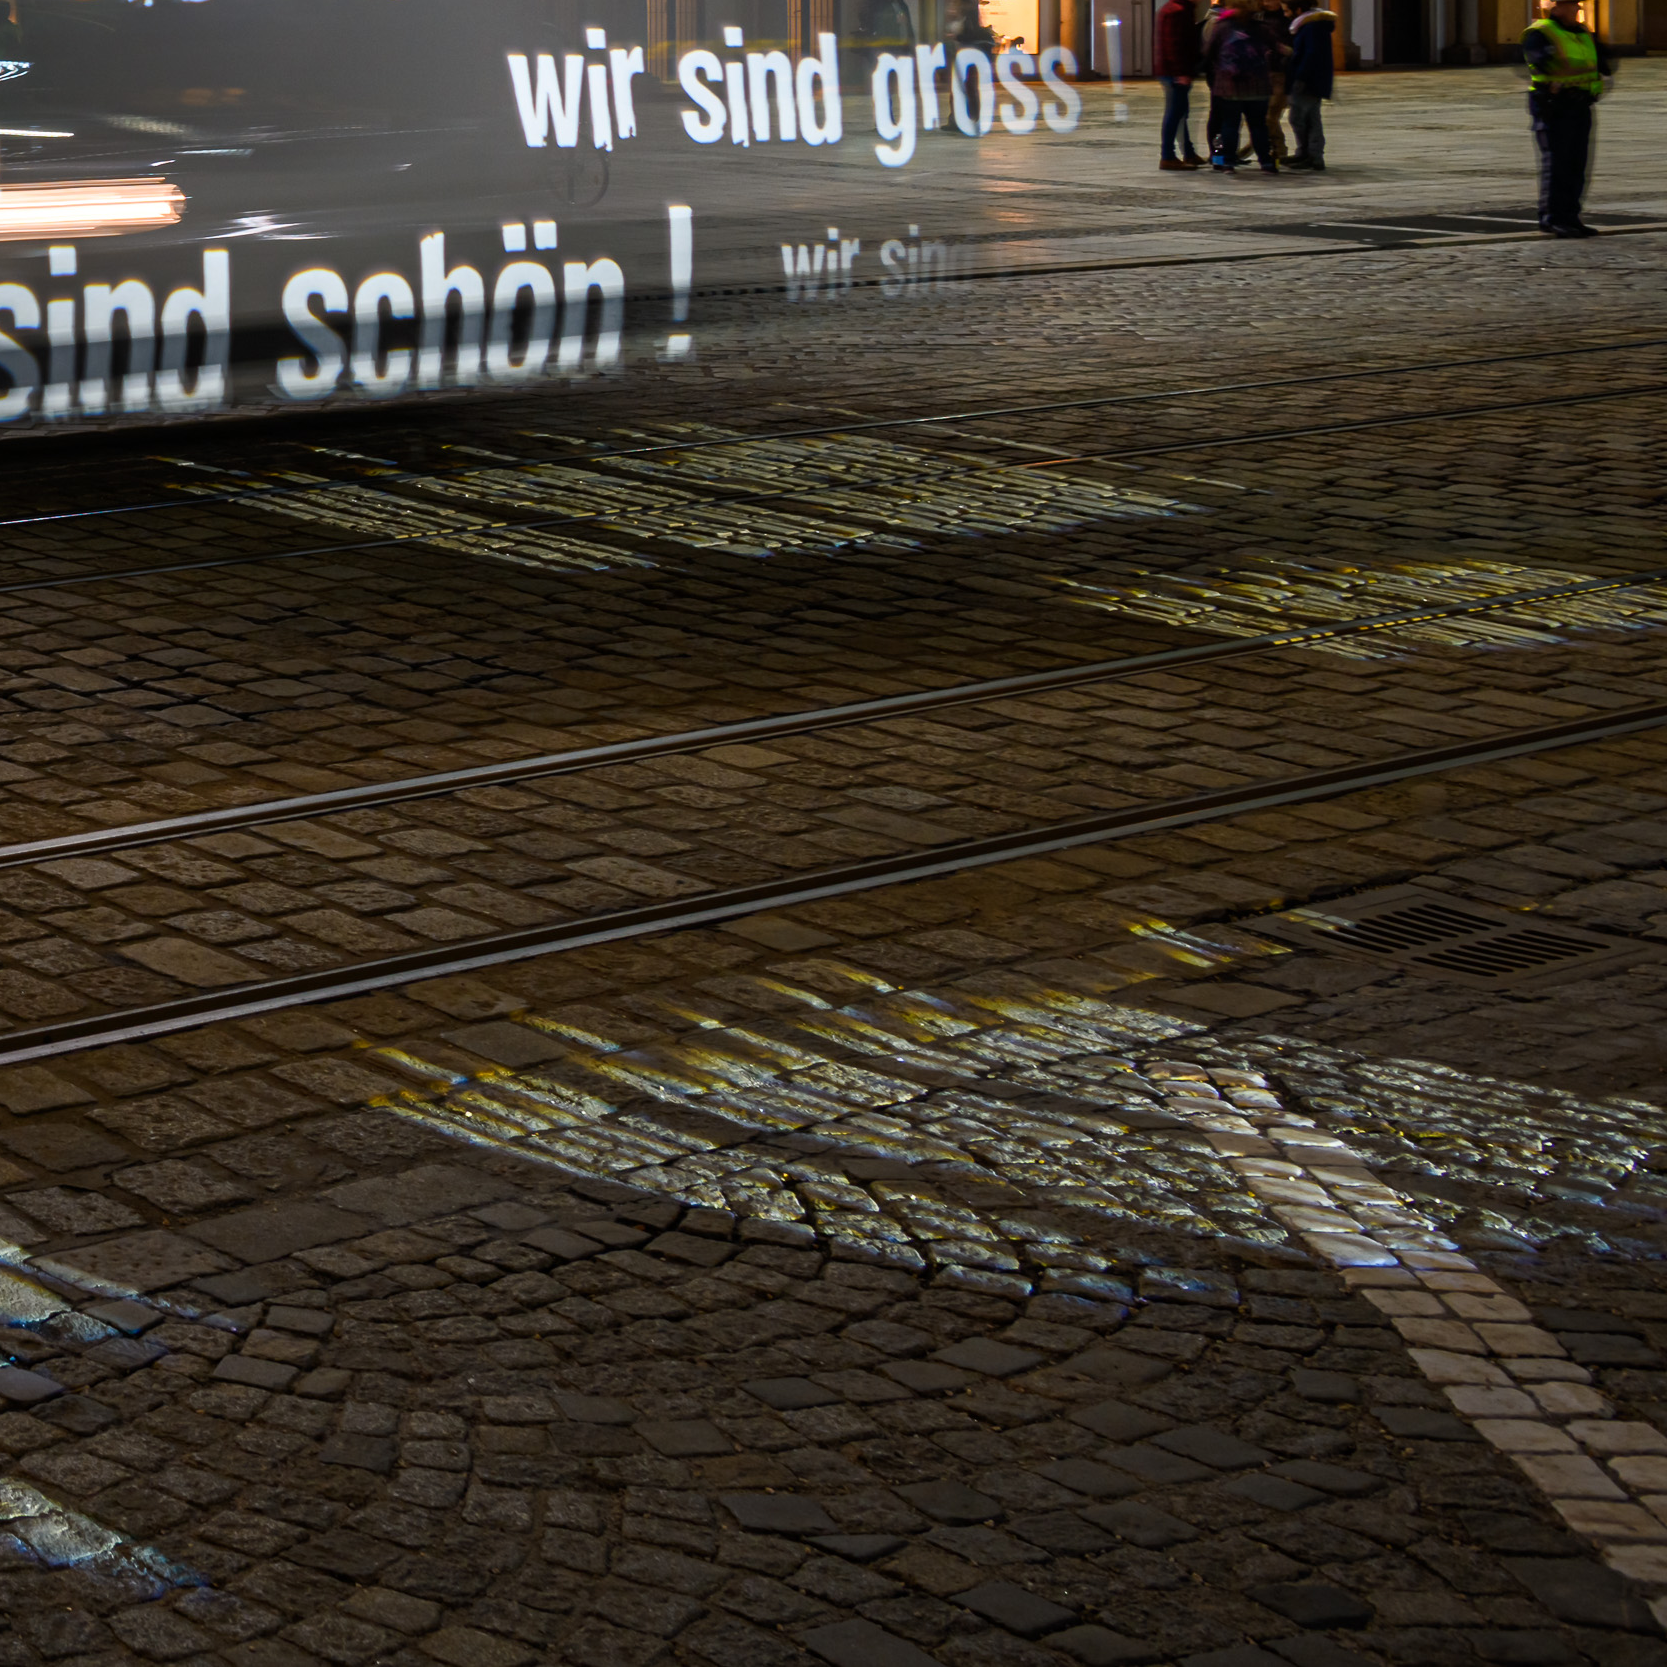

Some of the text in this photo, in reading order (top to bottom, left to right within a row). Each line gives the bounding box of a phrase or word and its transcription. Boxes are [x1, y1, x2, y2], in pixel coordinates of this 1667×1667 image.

[506, 26, 646, 152] wir
[677, 25, 843, 148] sind
[872, 40, 1083, 169] gross
[273, 218, 626, 401] schön
[781, 225, 861, 305] wir
